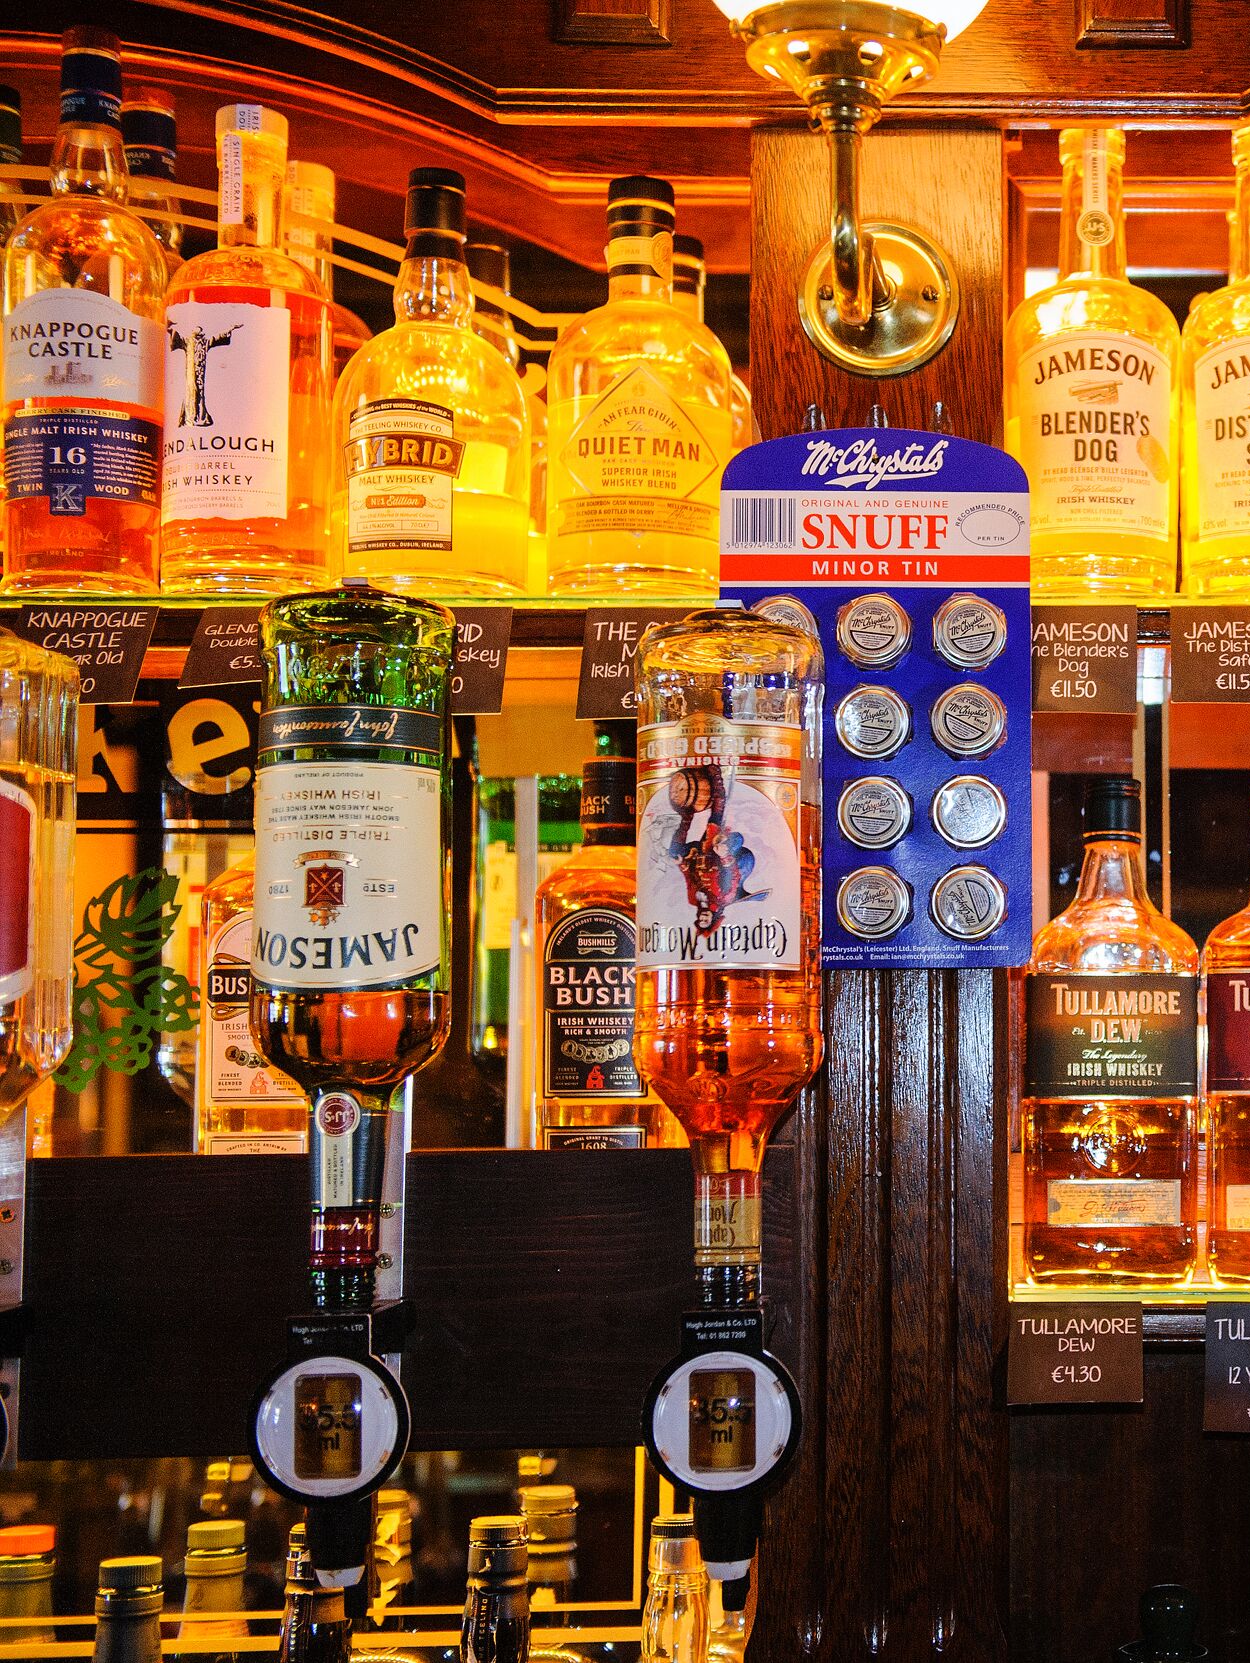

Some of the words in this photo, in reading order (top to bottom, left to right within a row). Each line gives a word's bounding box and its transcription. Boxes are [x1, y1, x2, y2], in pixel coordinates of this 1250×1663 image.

[10, 322, 138, 345] KNAPPOGUE
[28, 341, 112, 360] CASTLE
[1034, 348, 1156, 385] JAMESON
[365, 421, 391, 431] TEELING
[394, 421, 428, 430] WHISKEY
[1041, 410, 1150, 436] BLENDER'S
[5, 428, 28, 441] SINGLE
[31, 426, 59, 435] MALT
[63, 426, 97, 435] IRISH
[101, 429, 148, 444] WHISKEY
[50, 446, 86, 465] 16
[351, 438, 454, 471] HYBRID
[579, 437, 646, 458] QUIET
[653, 438, 700, 461] MAN
[1074, 439, 1118, 462] DOG
[359, 475, 381, 486] MALT
[386, 475, 435, 484] WHISKEY
[602, 468, 648, 476] SUPERIOR
[652, 468, 677, 478] IRISH
[17, 483, 43, 491] TWIN
[94, 484, 129, 495] WOOD
[602, 479, 643, 487] WHISKEY
[648, 480, 676, 489] BLEND
[802, 499, 860, 508] ORIGINAL
[865, 500, 889, 508] AND
[895, 500, 948, 508] GENUINE
[955, 503, 1006, 527] RECOMMENDED
[1007, 507, 1025, 526] PRICE
[802, 514, 948, 550] SNUFF
[812, 561, 889, 575] MINOR
[903, 561, 938, 575] TIN
[27, 612, 148, 628] KNAPPOGUE
[593, 622, 637, 641] THE
[43, 632, 123, 650] CASTLE
[1187, 639, 1217, 653] The
[96, 651, 124, 665] Old
[1053, 642, 1129, 659] Blender's
[591, 662, 629, 678] Irish
[1059, 659, 1089, 678] Dog
[1050, 679, 1097, 699] €11.50
[255, 923, 420, 970] JAMESON
[707, 916, 788, 960] Captain
[550, 966, 636, 985] BLACK
[556, 987, 631, 1006] BUSH
[1050, 983, 1181, 1016] TULLAMORE
[1090, 1018, 1142, 1044] D.E.W.
[1067, 1063, 1101, 1077] IRISH
[1106, 1063, 1163, 1077] WHISKEY
[1018, 1318, 1137, 1335] TULLAMORE
[1058, 1338, 1095, 1353] DEW
[1051, 1366, 1102, 1383] €4.30
[1228, 1366, 1241, 1383] 12
